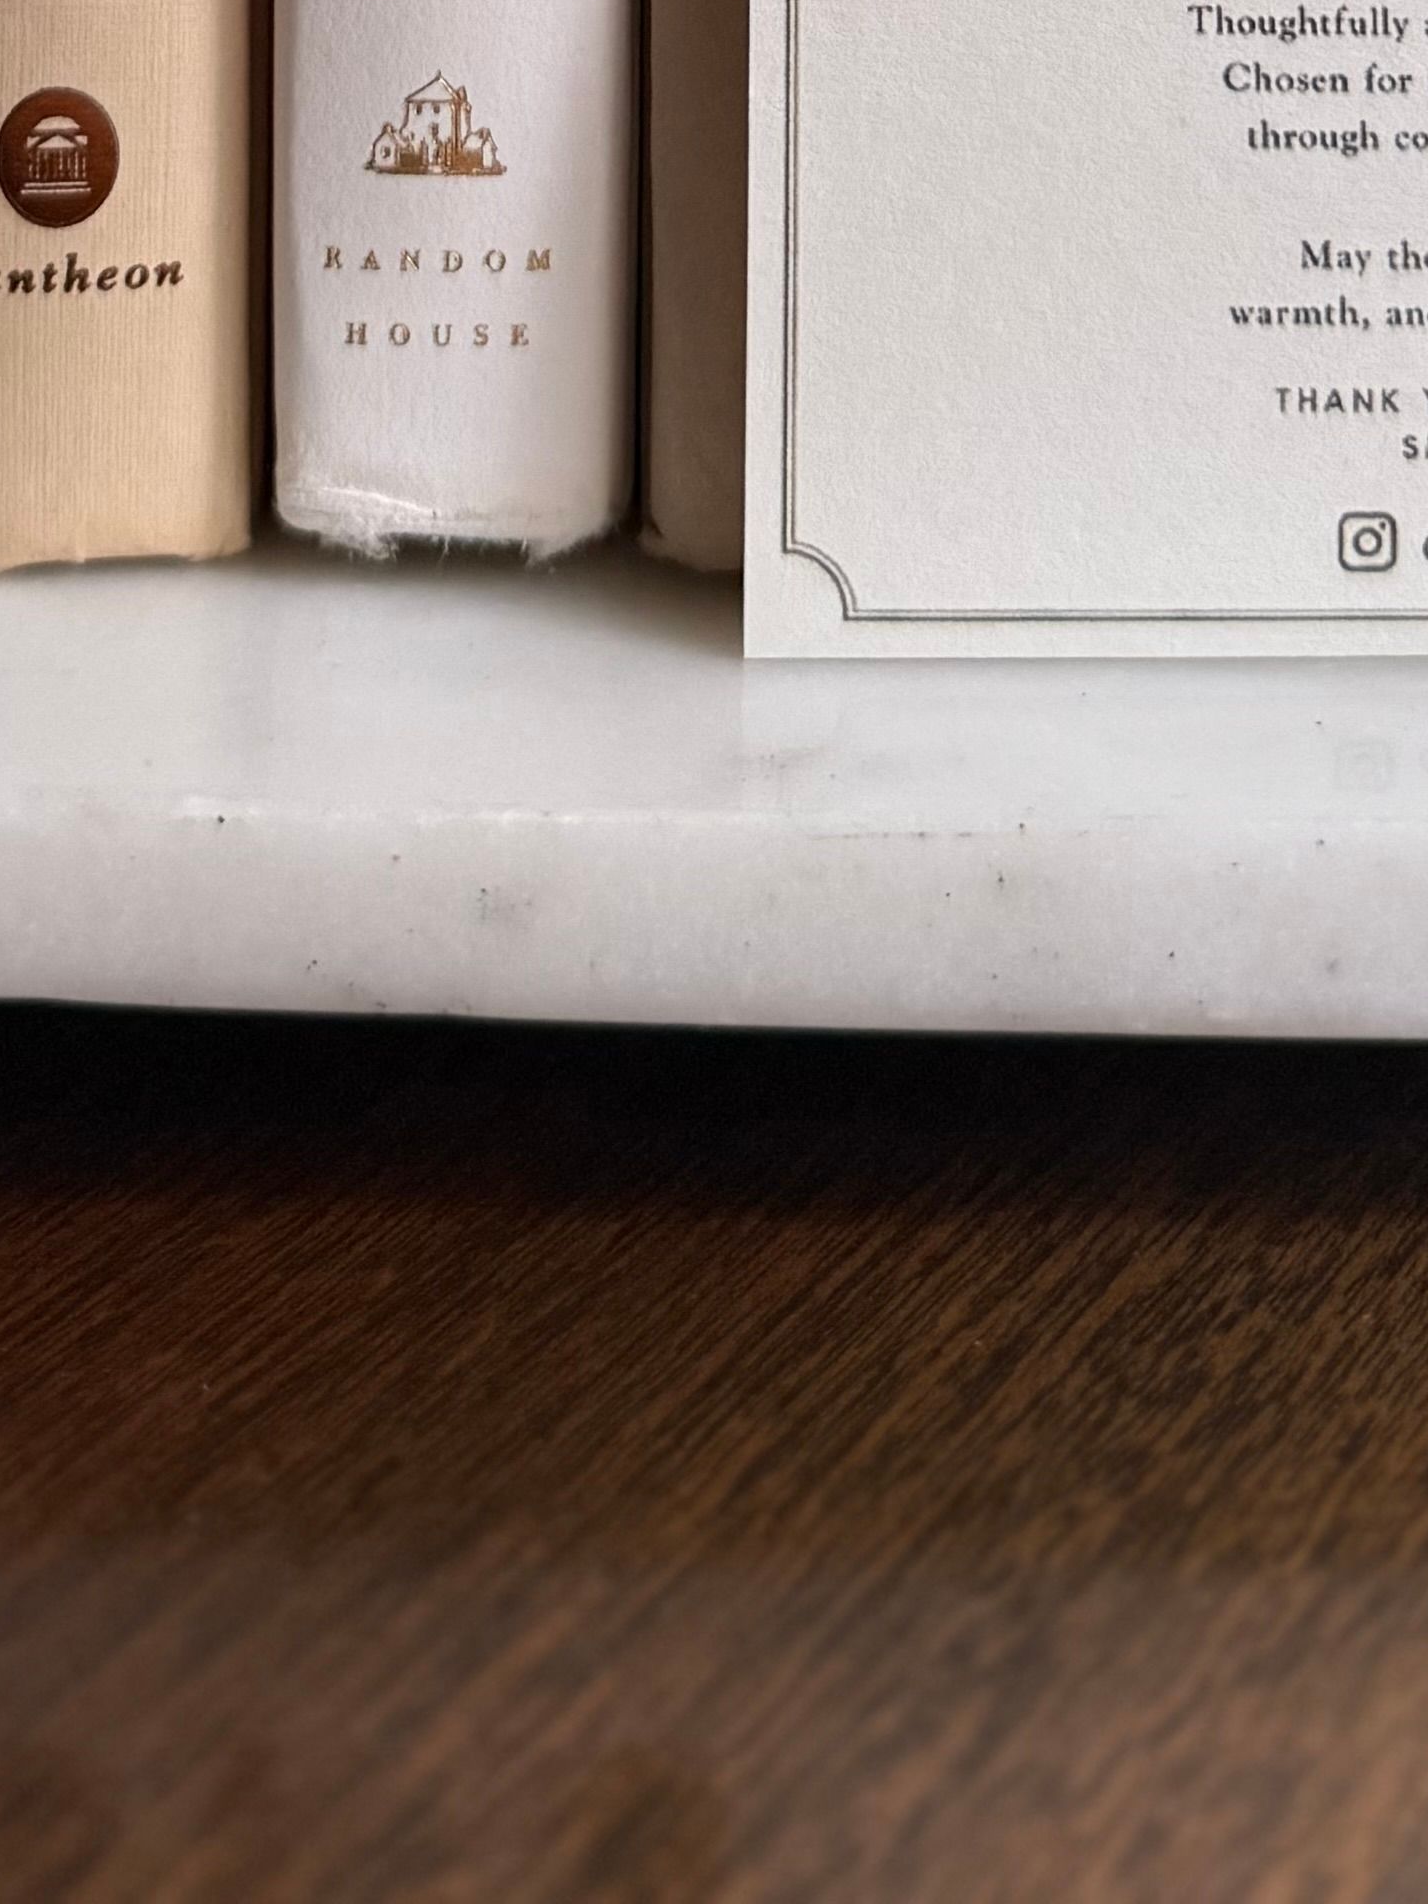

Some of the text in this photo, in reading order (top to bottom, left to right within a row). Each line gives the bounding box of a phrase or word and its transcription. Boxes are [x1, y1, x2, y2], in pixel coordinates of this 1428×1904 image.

[1185, 2, 1411, 47] Thoughtfully
[1220, 59, 1352, 98] Chosen
[1363, 60, 1416, 98] for
[1246, 117, 1382, 161] through
[322, 245, 553, 273] RANDOM
[1299, 238, 1373, 280] May
[343, 321, 531, 347] HOUSE
[1227, 292, 1373, 336] warmth,
[1272, 385, 1402, 418] THANK
